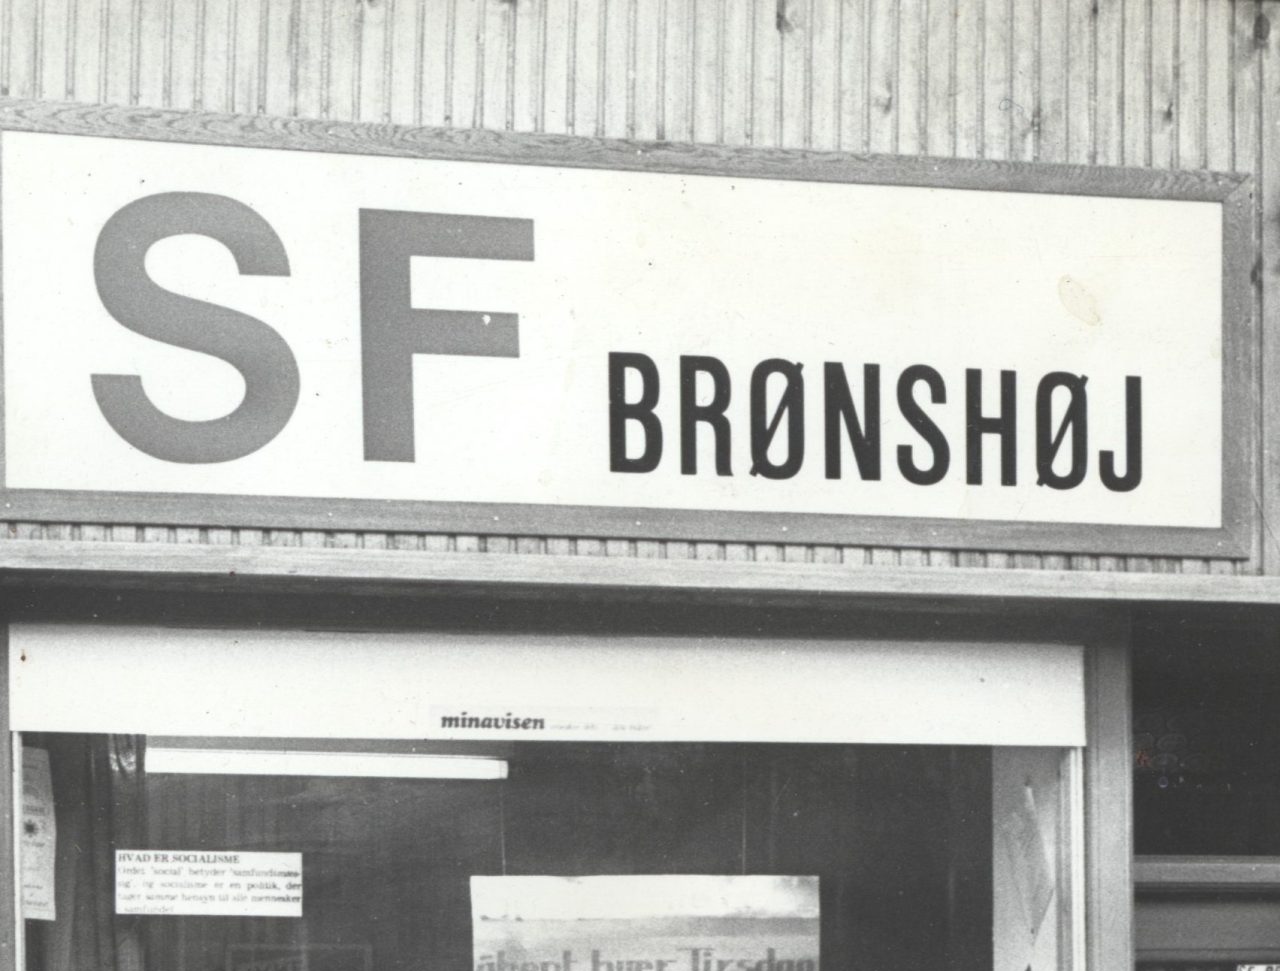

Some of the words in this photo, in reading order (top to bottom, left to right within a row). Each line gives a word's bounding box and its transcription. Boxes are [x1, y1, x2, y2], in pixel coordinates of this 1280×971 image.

[90, 190, 536, 464] SF
[608, 351, 1143, 492] BRØNSHØJ
[440, 711, 546, 731] minavisen
[118, 852, 152, 864] HVAD
[154, 853, 170, 864] ER
[172, 853, 240, 865] SOCIALISME
